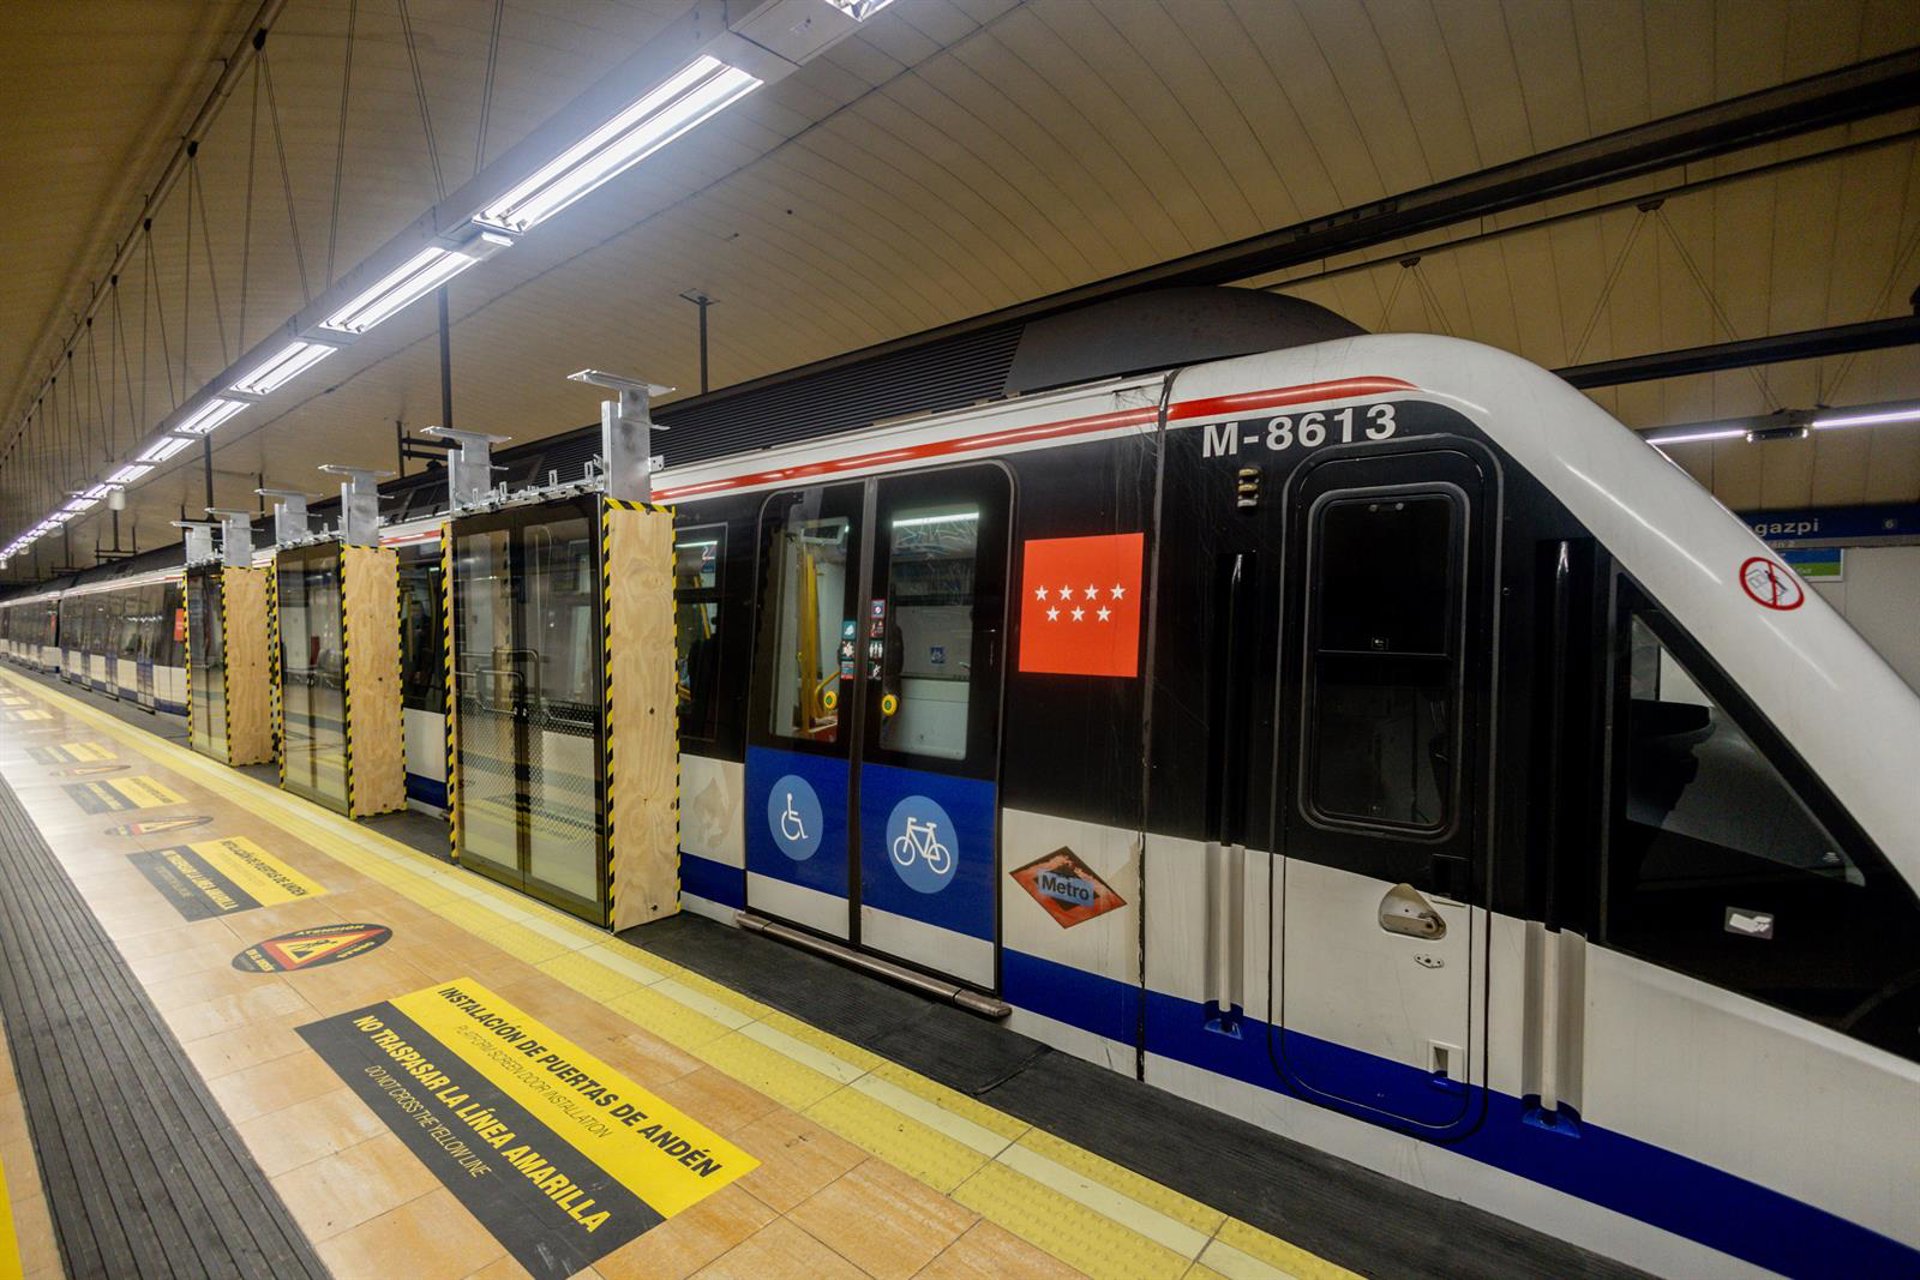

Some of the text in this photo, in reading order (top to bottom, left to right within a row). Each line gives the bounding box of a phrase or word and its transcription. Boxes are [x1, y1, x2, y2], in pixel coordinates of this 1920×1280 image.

[1203, 404, 1396, 458] M-8613
[1755, 518, 1819, 537] gazpi
[1042, 875, 1089, 900] Metro
[438, 987, 722, 1178] INSTALACIÓN DE PUERTAS DE ANDÉN
[516, 1070, 552, 1093] DOOR
[544, 1089, 612, 1138] INSTALLATION
[353, 1014, 612, 1233] NO TRASPASAR LA LÍNEA AMARILLA
[365, 1065, 491, 1178] DO NOT CROSS THE YELLOW LINE
